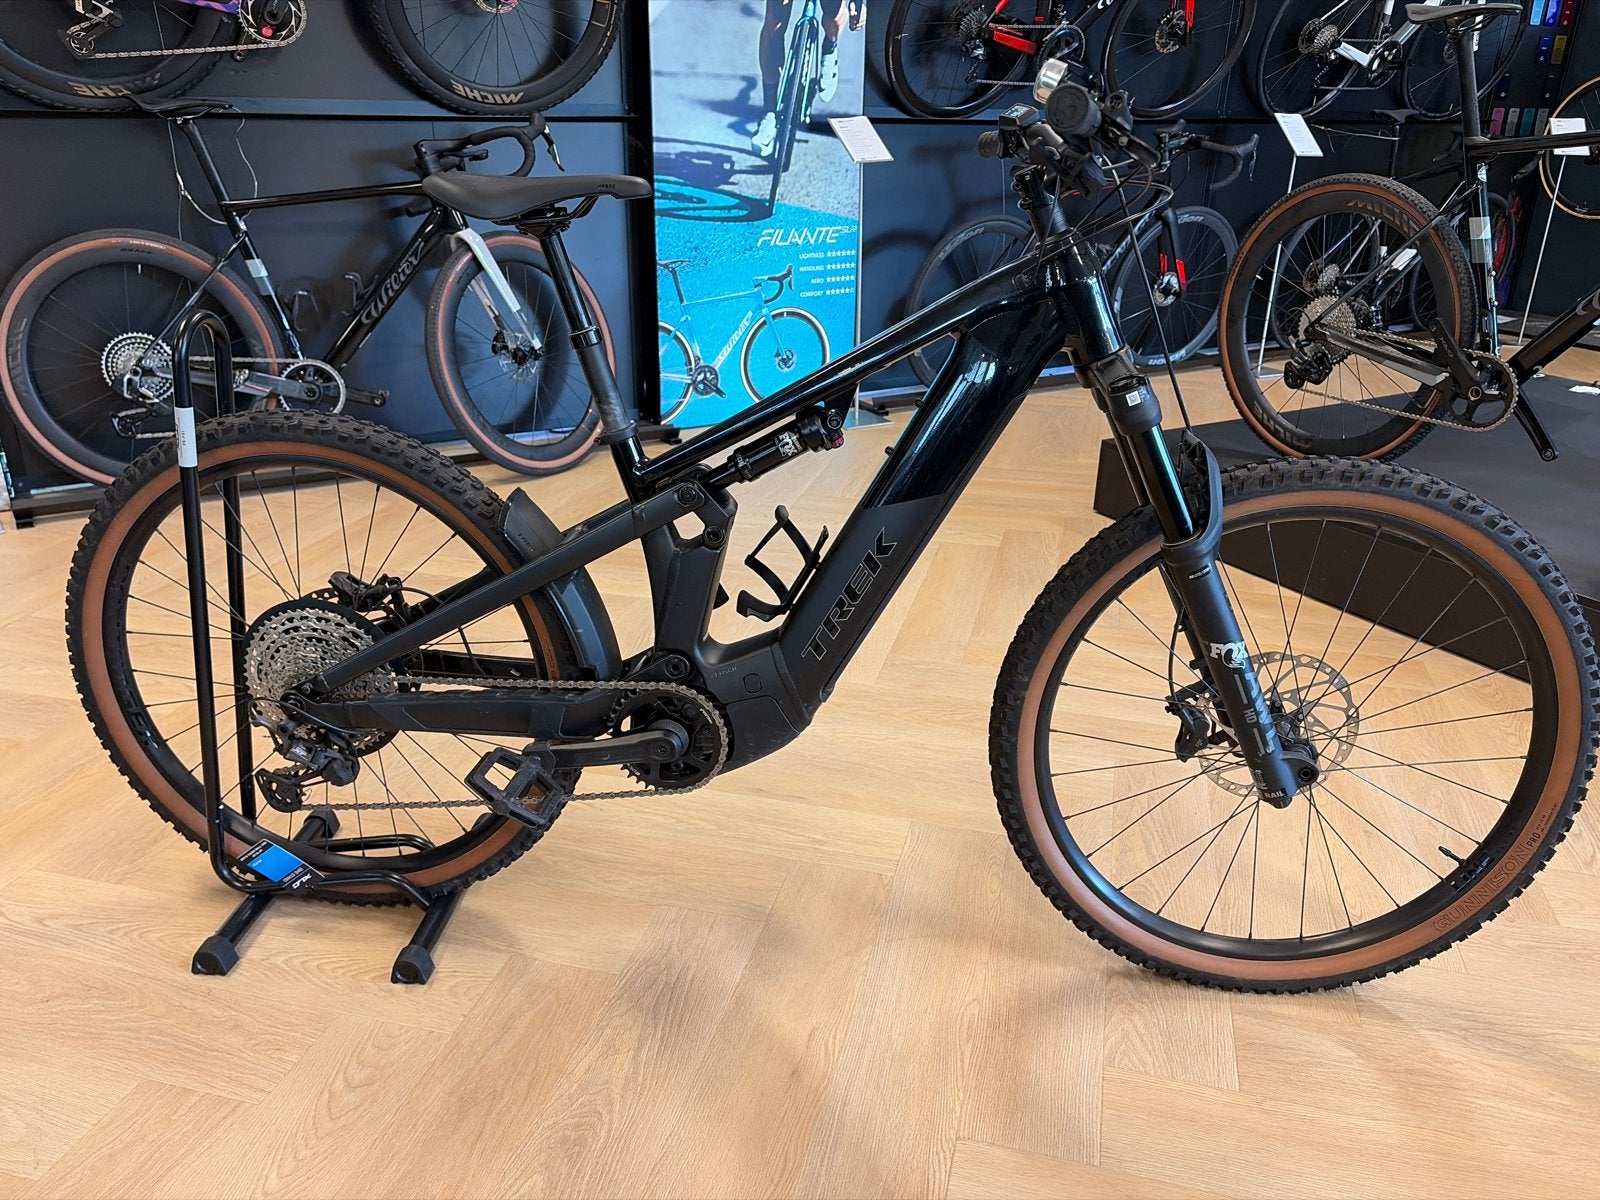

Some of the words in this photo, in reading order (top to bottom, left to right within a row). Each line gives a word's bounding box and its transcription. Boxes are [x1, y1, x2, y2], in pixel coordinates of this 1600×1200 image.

[450, 79, 524, 104] MICHE
[756, 226, 842, 247] FILANTE
[799, 252, 825, 260] LIGHTNESS
[361, 238, 425, 324] Wilier
[810, 277, 825, 285] AERO
[799, 289, 824, 298] COMFORT
[801, 526, 898, 661] TREK
[1209, 640, 1249, 669] FOX
[1243, 708, 1257, 724] HD
[1264, 790, 1285, 800] RAIL
[292, 873, 312, 889] XLC
[1432, 843, 1529, 931] GUNNISON
[1526, 831, 1541, 850] PRO
